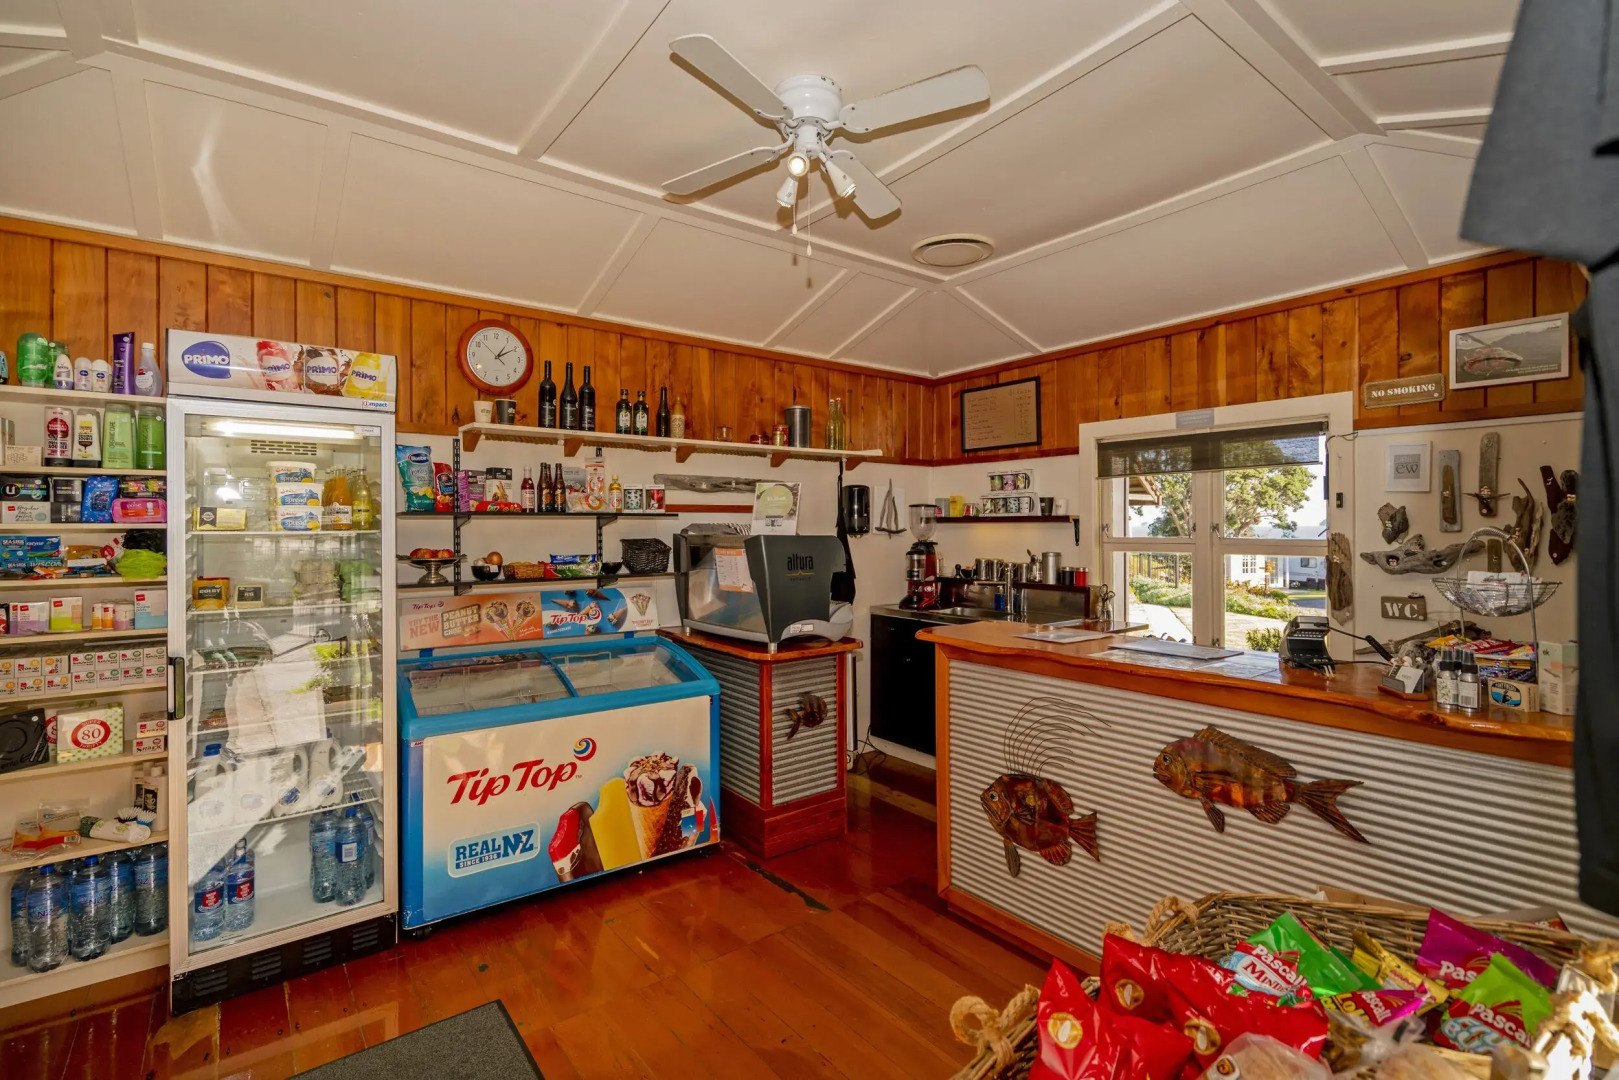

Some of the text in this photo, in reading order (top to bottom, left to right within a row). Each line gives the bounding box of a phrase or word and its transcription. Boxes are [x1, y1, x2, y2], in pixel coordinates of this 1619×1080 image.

[184, 353, 230, 366] PRIMO
[306, 365, 337, 374] PRIMO
[351, 369, 377, 382] PRIMO
[1371, 383, 1436, 398] NO SMOKING
[787, 553, 814, 571] altura
[443, 605, 478, 621] PEANUT
[550, 613, 587, 625] Tip Top
[409, 621, 440, 639] NEW
[443, 614, 479, 630] BUTTER
[82, 728, 101, 740] 80
[447, 767, 511, 806] Tip
[512, 758, 578, 791] Top
[455, 829, 534, 862] REAL NZ
[459, 854, 498, 868] SINCE 1936
[1252, 943, 1307, 987] Pascall
[1440, 960, 1478, 983] Pas
